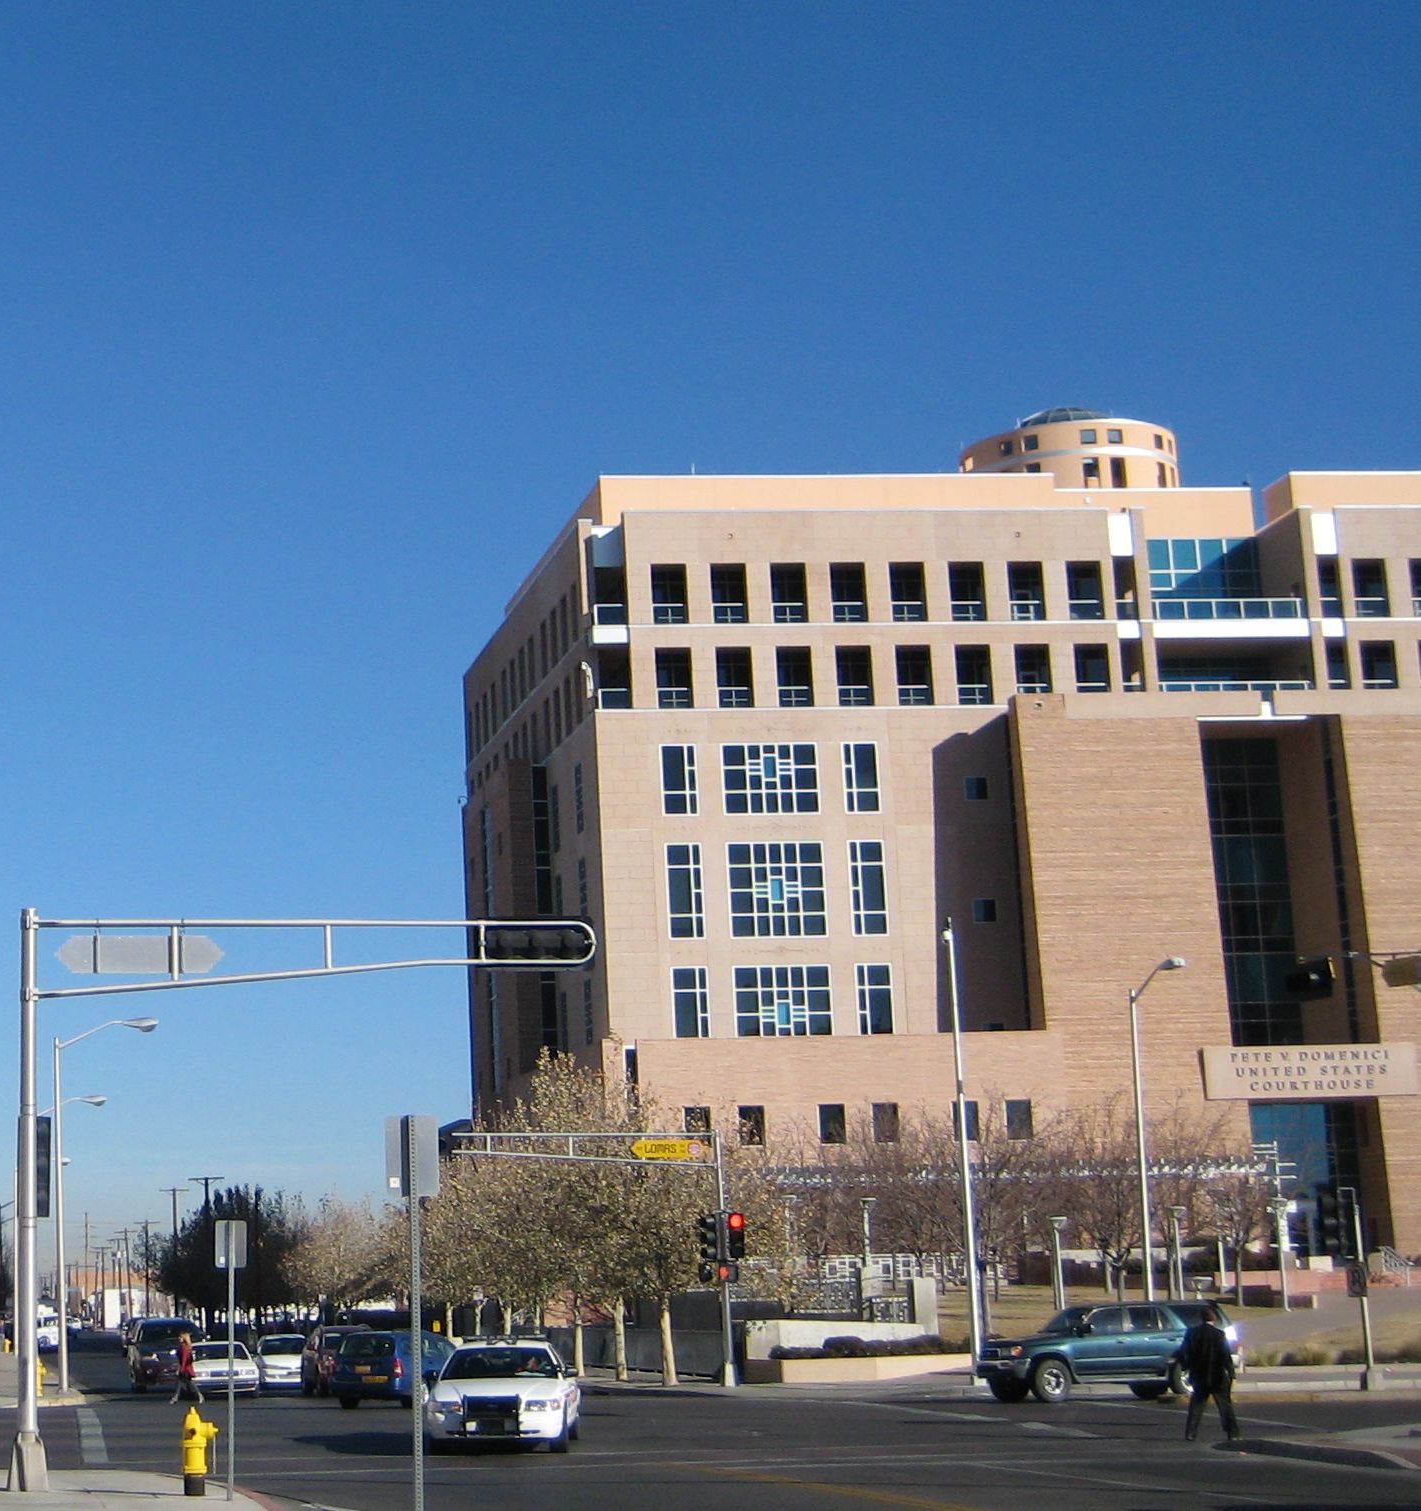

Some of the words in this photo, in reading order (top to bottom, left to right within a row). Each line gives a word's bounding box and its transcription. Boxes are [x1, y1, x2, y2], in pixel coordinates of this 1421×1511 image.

[1230, 1052, 1272, 1063] PETE
[1299, 1050, 1390, 1061] DOMENICI
[1235, 1066, 1307, 1078] UNITED
[1320, 1064, 1388, 1075] STATES
[1249, 1079, 1375, 1092] COURTHOUSE
[644, 1144, 677, 1153] LOMAS
